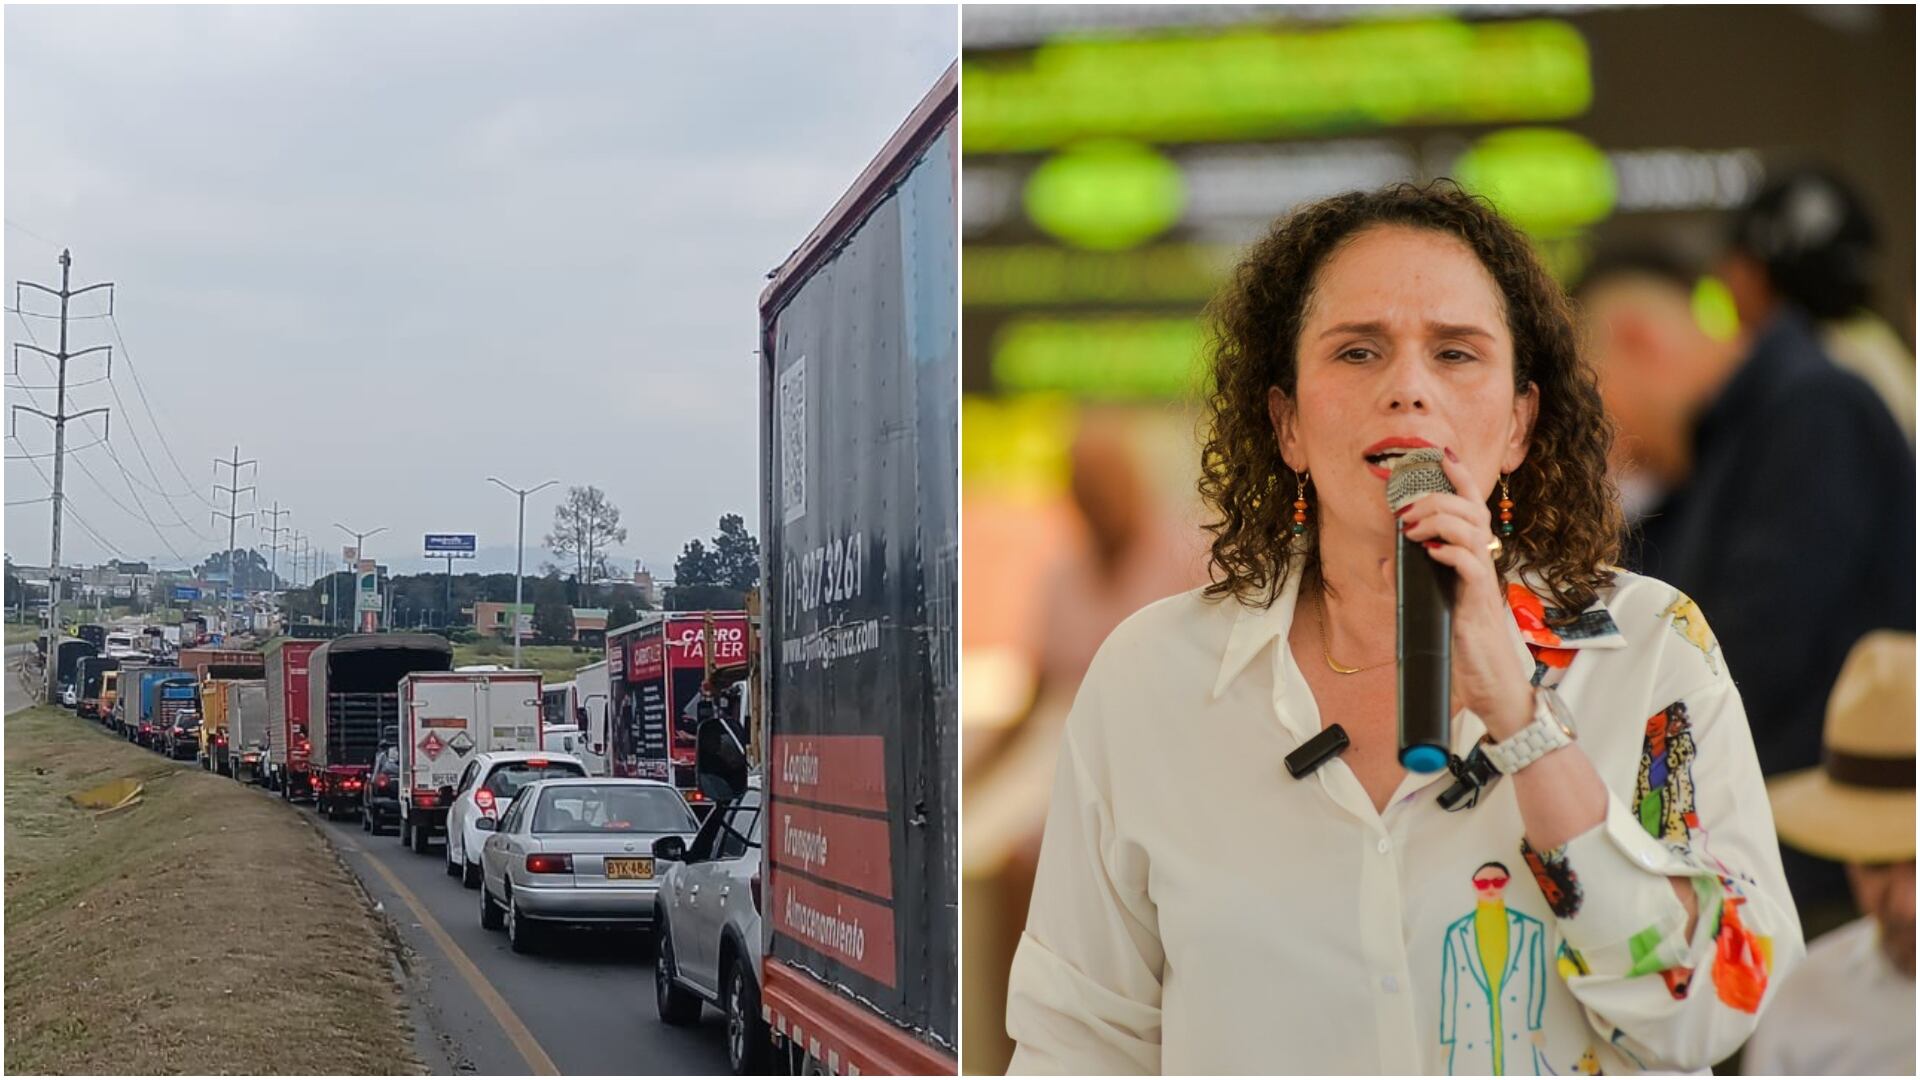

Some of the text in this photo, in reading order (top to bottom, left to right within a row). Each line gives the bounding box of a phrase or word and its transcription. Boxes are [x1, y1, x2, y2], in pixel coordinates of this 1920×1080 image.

[682, 641, 744, 659] TALER
[783, 814, 828, 871] Transporte
[785, 884, 866, 961] Almacenamiento
